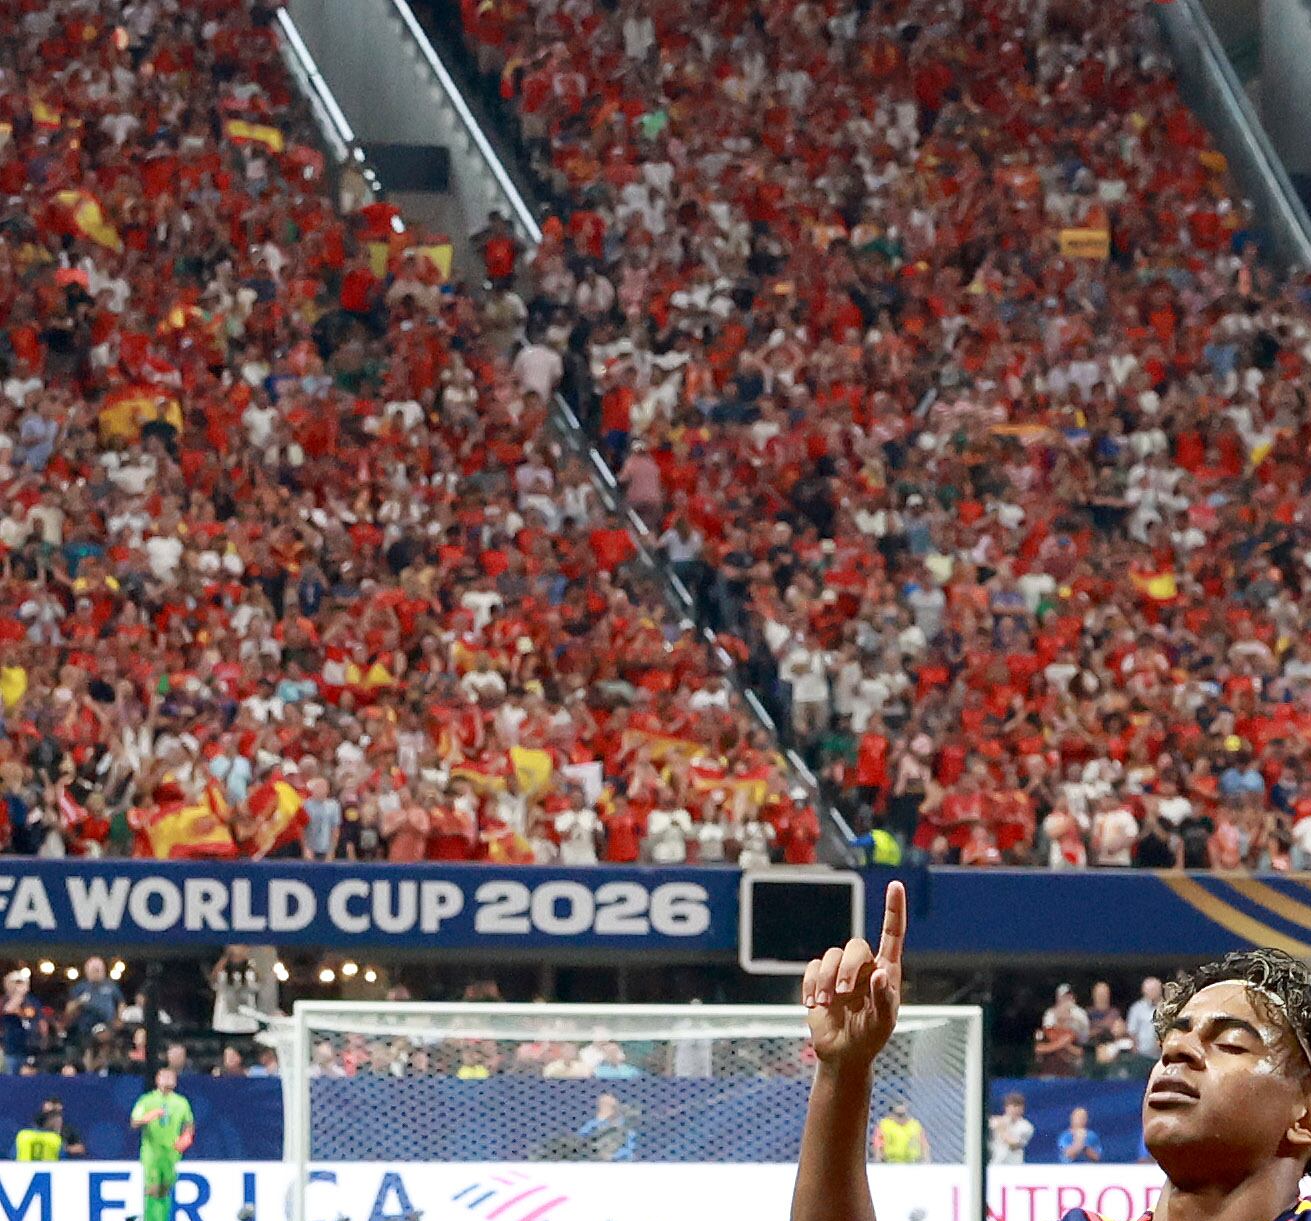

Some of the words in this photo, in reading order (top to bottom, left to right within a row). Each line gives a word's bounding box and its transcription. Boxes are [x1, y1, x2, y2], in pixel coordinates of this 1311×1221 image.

[65, 876, 316, 932] WORLD
[328, 879, 464, 934] CUP
[474, 881, 711, 936] 2026
